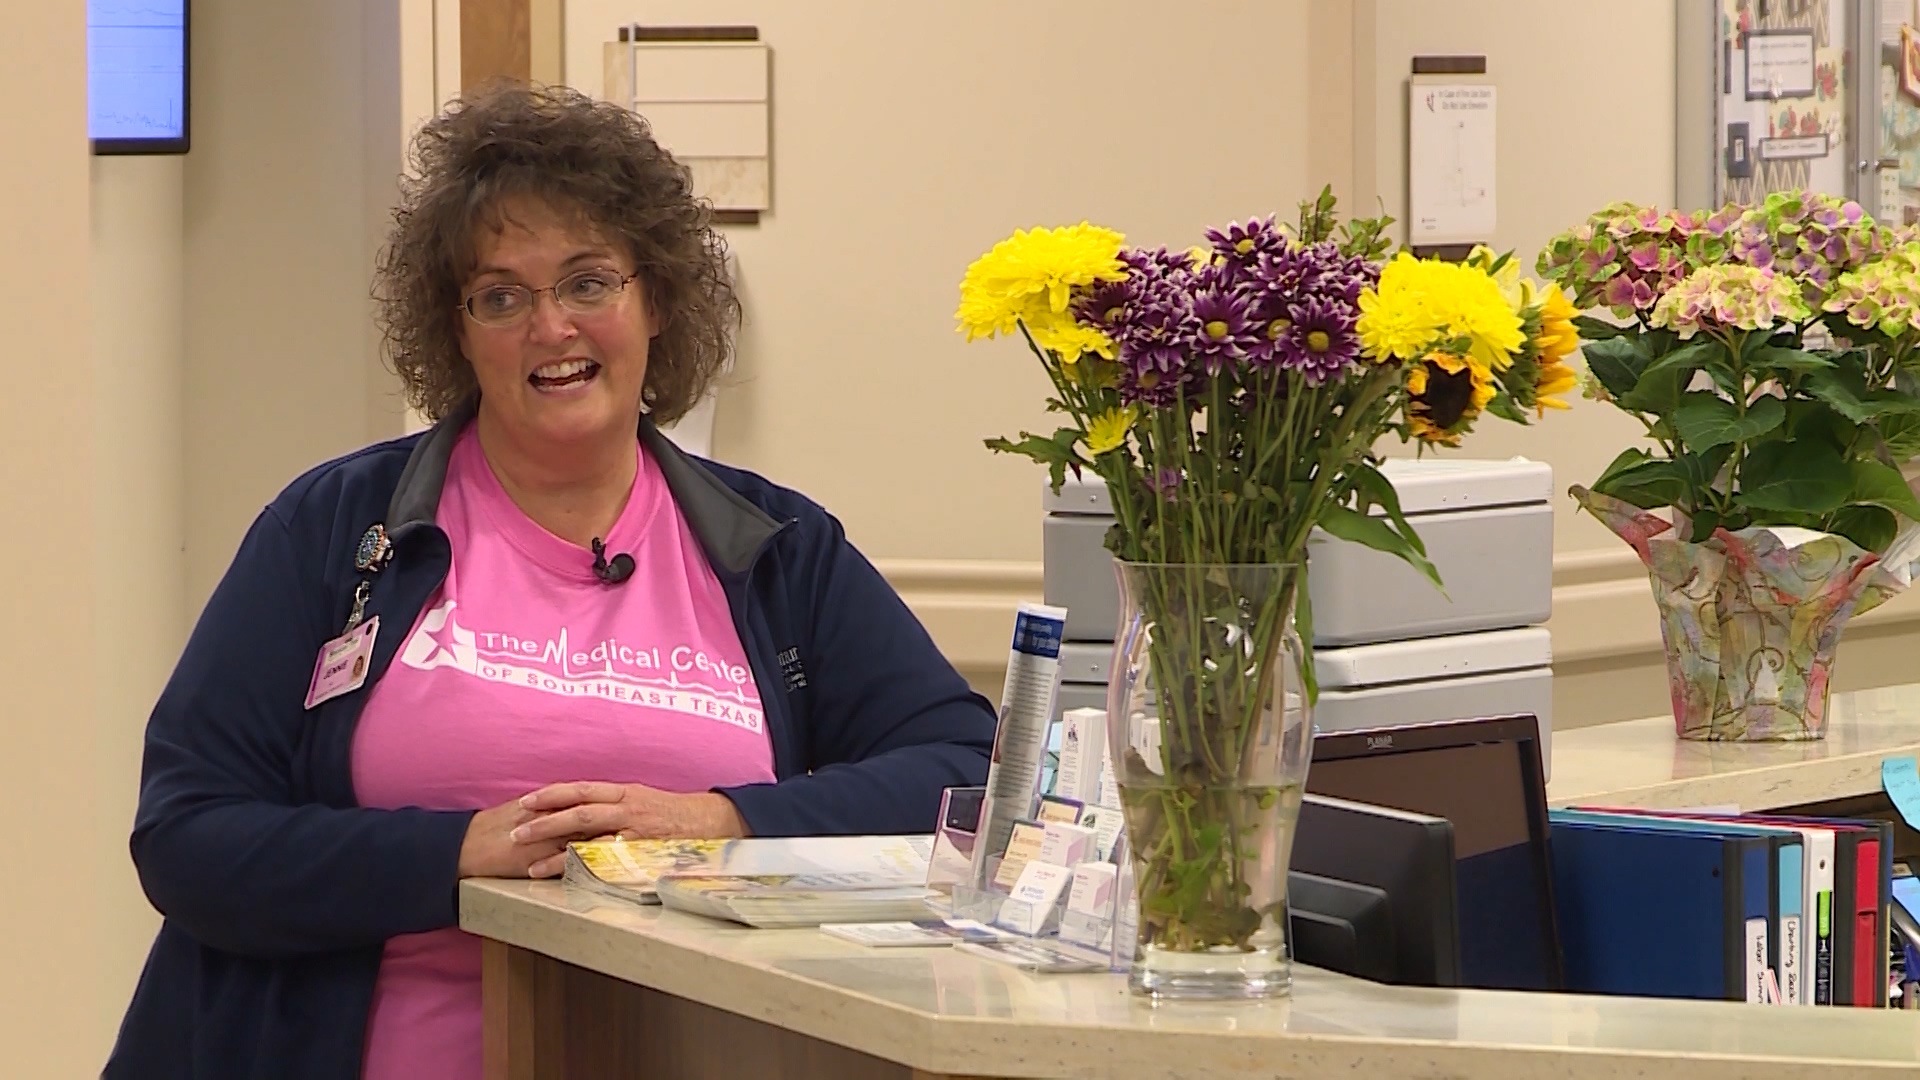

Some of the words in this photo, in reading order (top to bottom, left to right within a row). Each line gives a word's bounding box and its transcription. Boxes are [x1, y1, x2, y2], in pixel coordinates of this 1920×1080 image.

[480, 632, 538, 654] The
[543, 627, 661, 674] Medical
[482, 663, 513, 681] OF
[526, 672, 678, 706] SOUTHEAST
[691, 695, 758, 729] TEXAS
